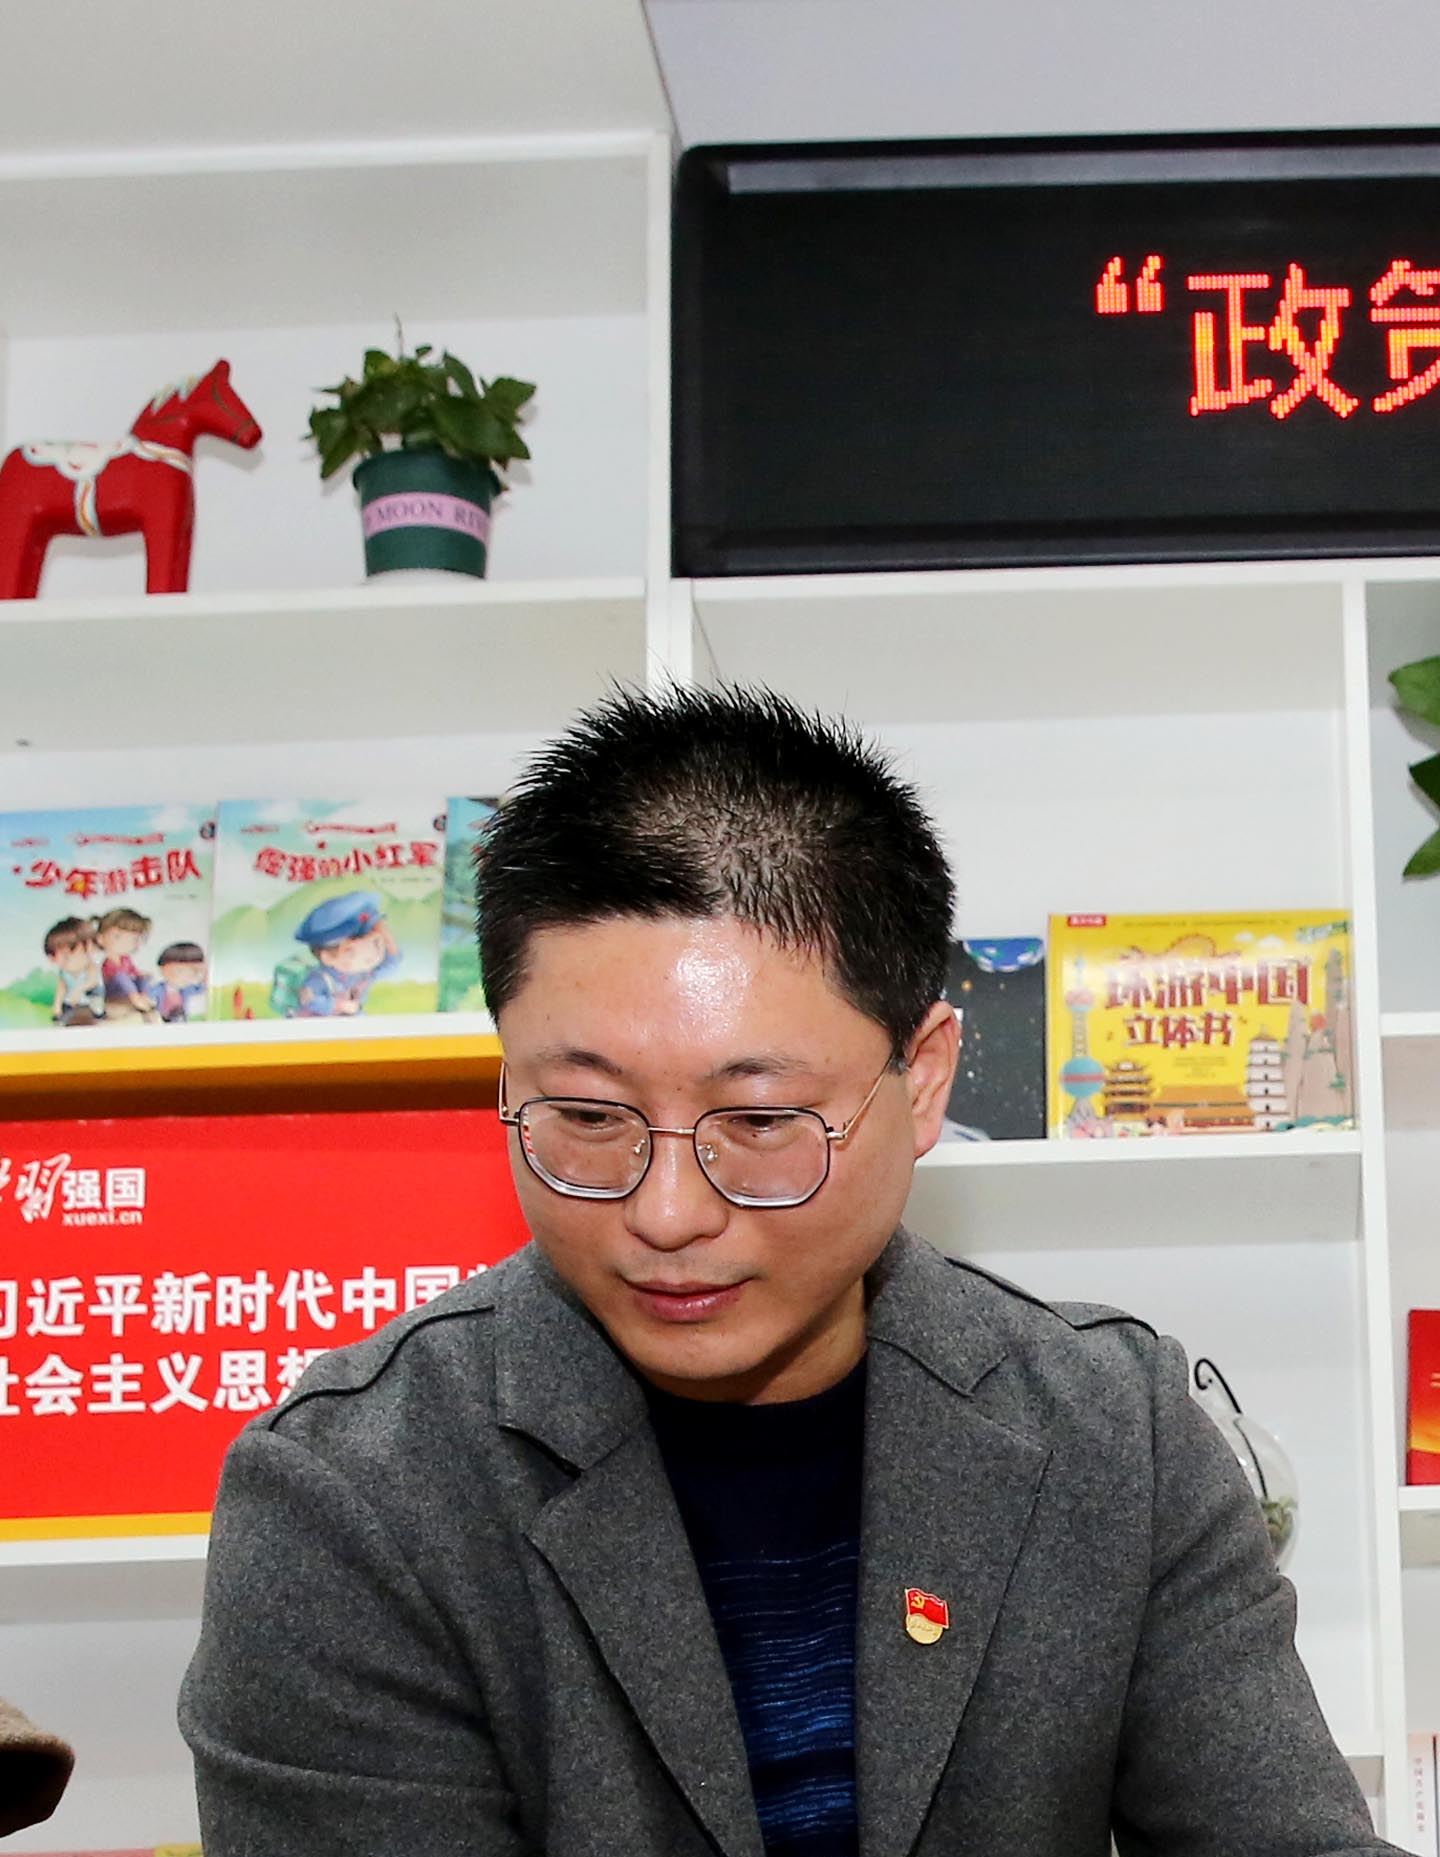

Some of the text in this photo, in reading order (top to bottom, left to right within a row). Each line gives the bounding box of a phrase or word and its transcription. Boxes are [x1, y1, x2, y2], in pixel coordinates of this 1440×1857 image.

[1123, 1012, 1233, 1049] 立体书
[62, 1211, 143, 1226] xuexi.cn
